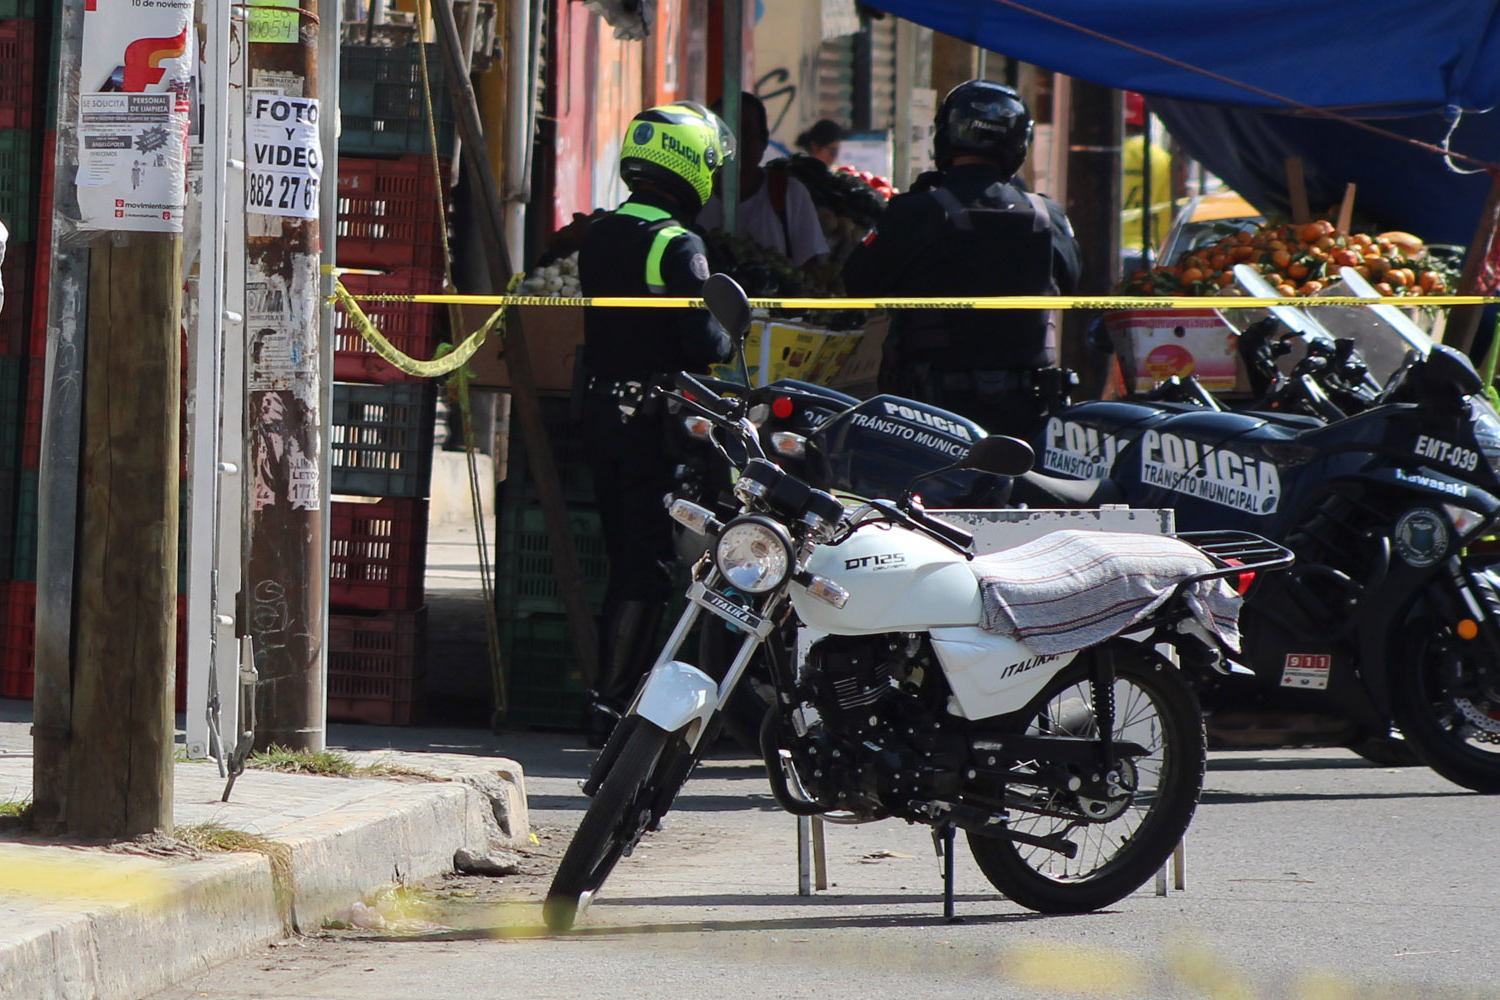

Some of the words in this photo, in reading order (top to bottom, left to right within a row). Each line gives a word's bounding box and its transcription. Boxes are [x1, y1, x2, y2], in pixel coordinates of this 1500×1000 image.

[132, 96, 166, 104] PERSONAL
[256, 99, 318, 125] FOTO
[284, 127, 296, 141] Y
[254, 143, 318, 169] VIDEO
[249, 172, 274, 208] 882
[278, 175, 301, 209] 27
[850, 412, 914, 440] TRÁNSITO
[1414, 434, 1479, 472] EMT-039
[1396, 468, 1468, 498] Kawasaki
[1200, 481, 1259, 513] MUNICIPAL
[844, 552, 906, 571] DT125
[711, 597, 750, 622] ITALIKA
